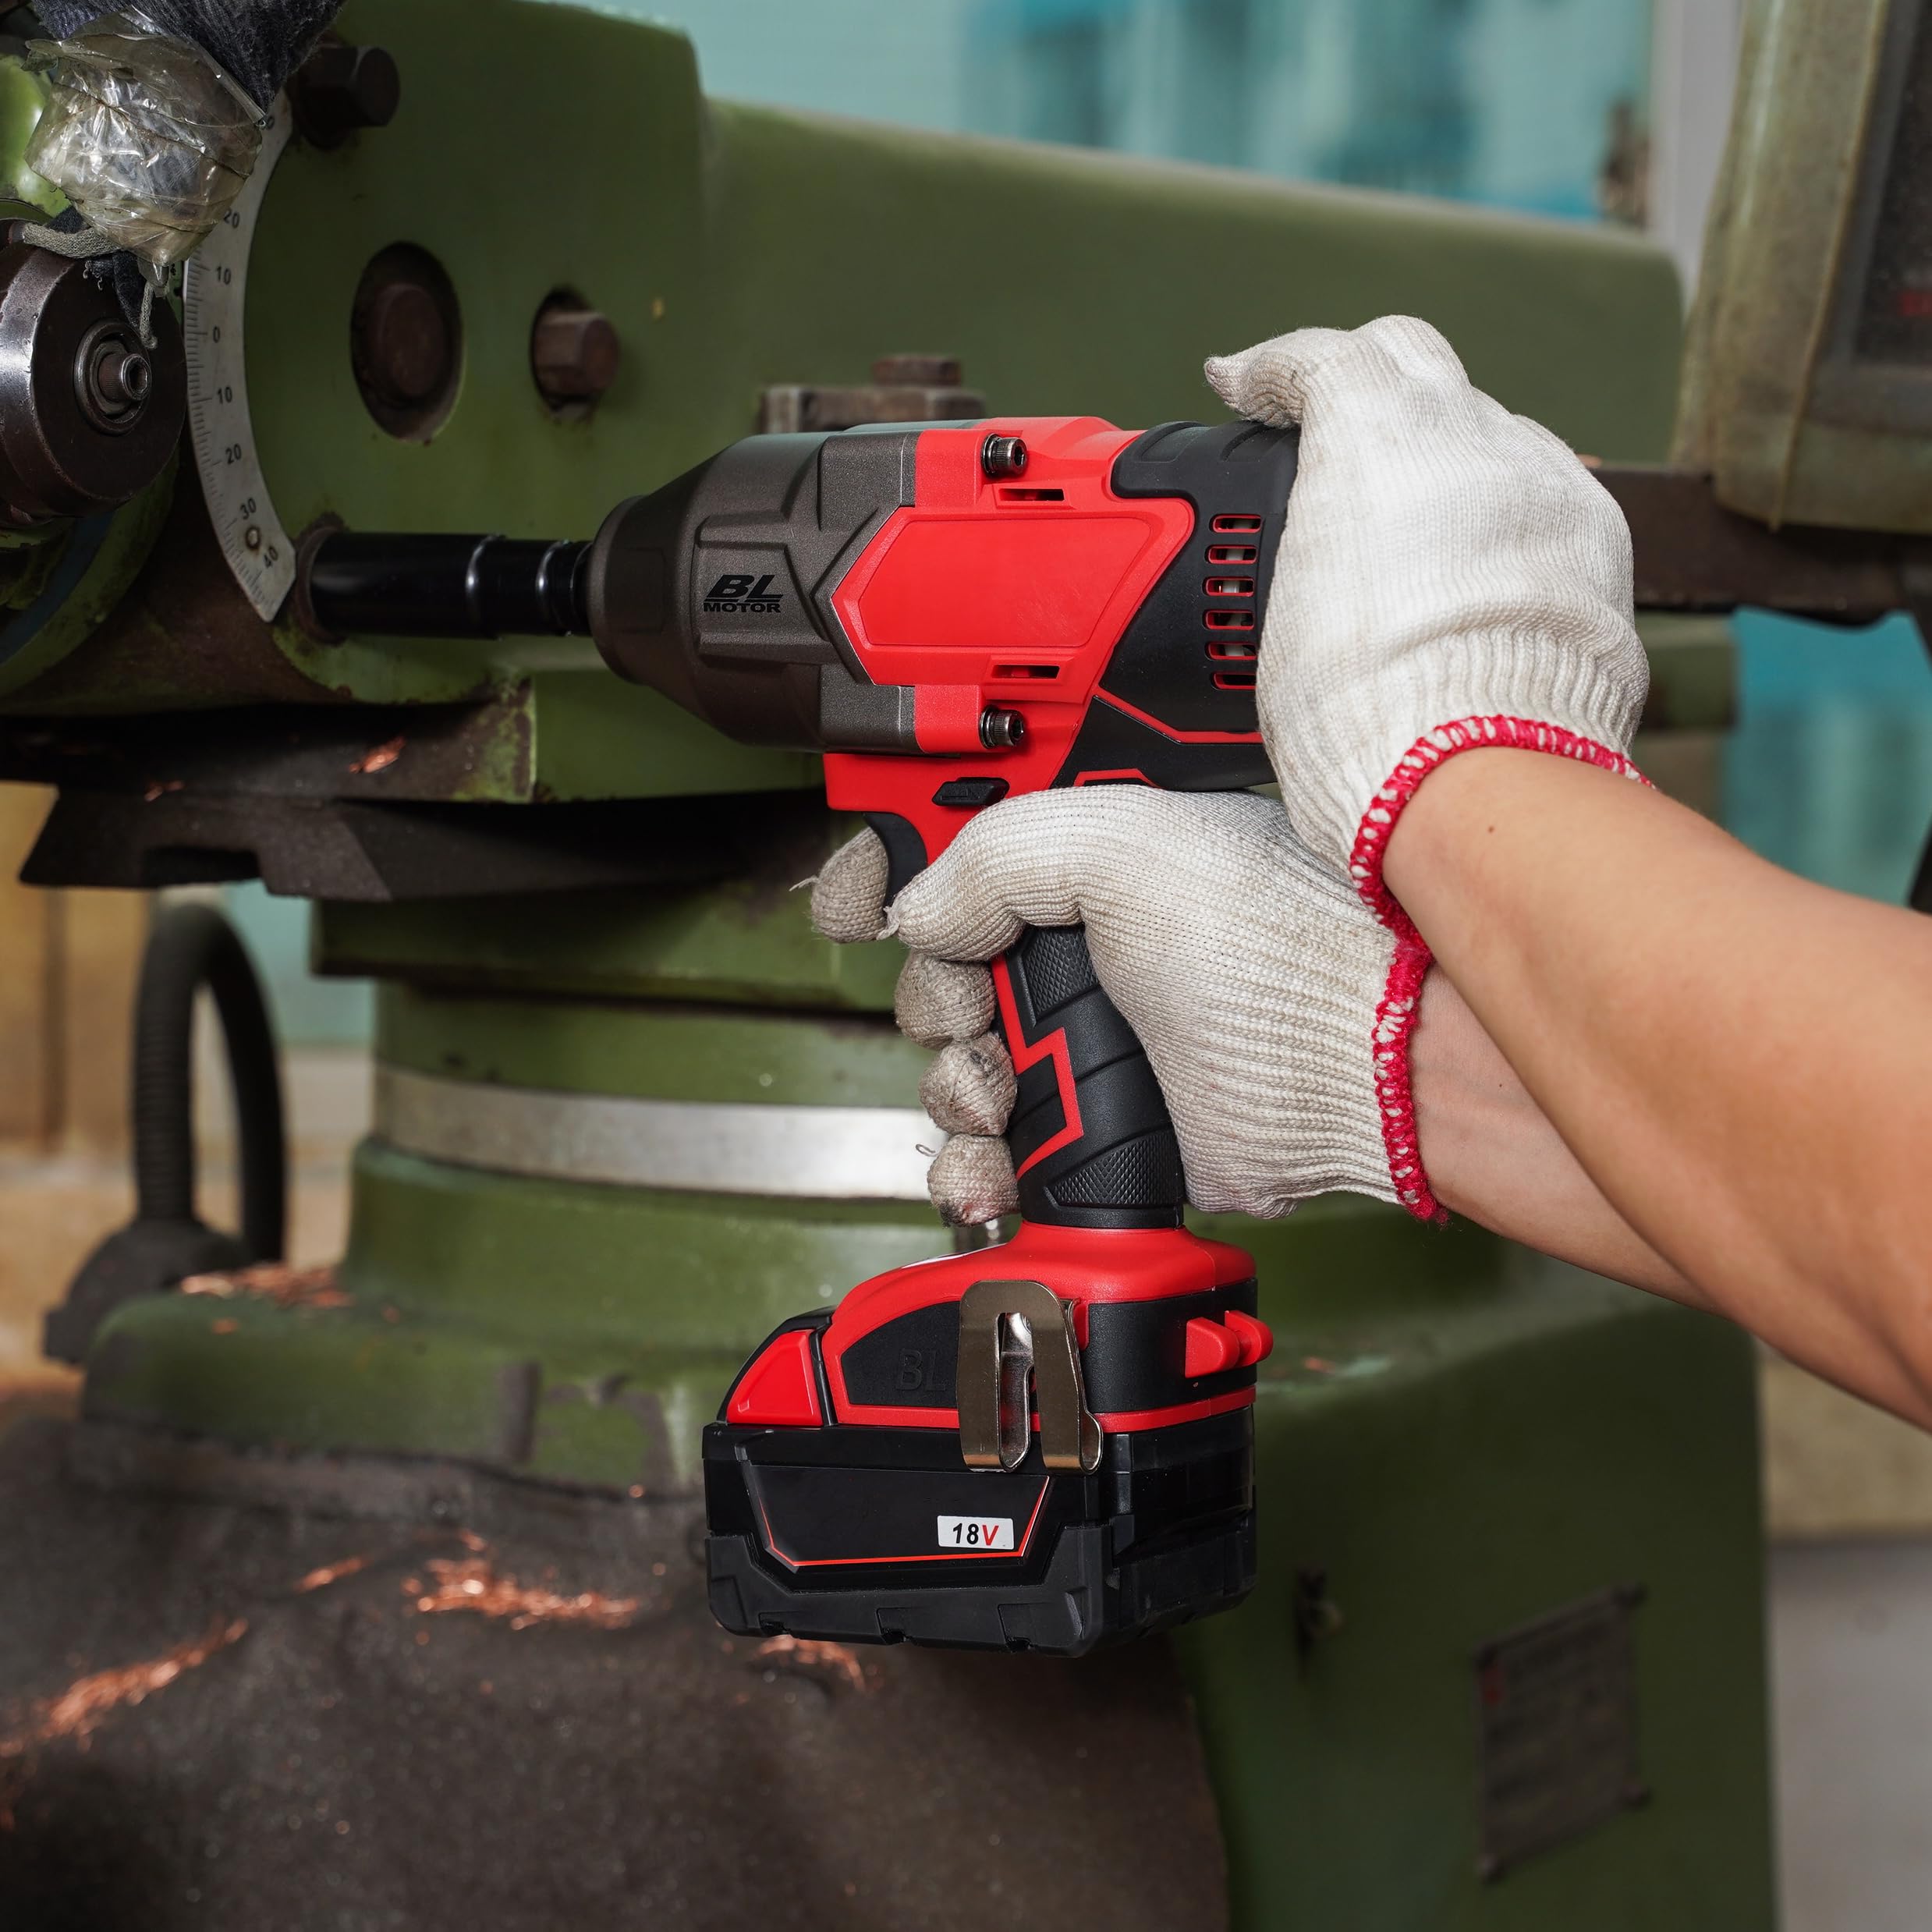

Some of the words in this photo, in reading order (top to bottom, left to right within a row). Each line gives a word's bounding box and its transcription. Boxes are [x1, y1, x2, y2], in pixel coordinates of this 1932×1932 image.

[222, 207, 240, 229] 20
[215, 264, 232, 285] 10
[212, 326, 221, 343] 0
[218, 386, 233, 404] 10
[225, 444, 242, 465] 20
[239, 497, 257, 520] 30
[264, 546, 279, 569] 40
[704, 574, 784, 600] BL
[703, 602, 782, 613] MOTOR
[898, 1349, 946, 1391] BL
[952, 1523, 999, 1546] 18V
